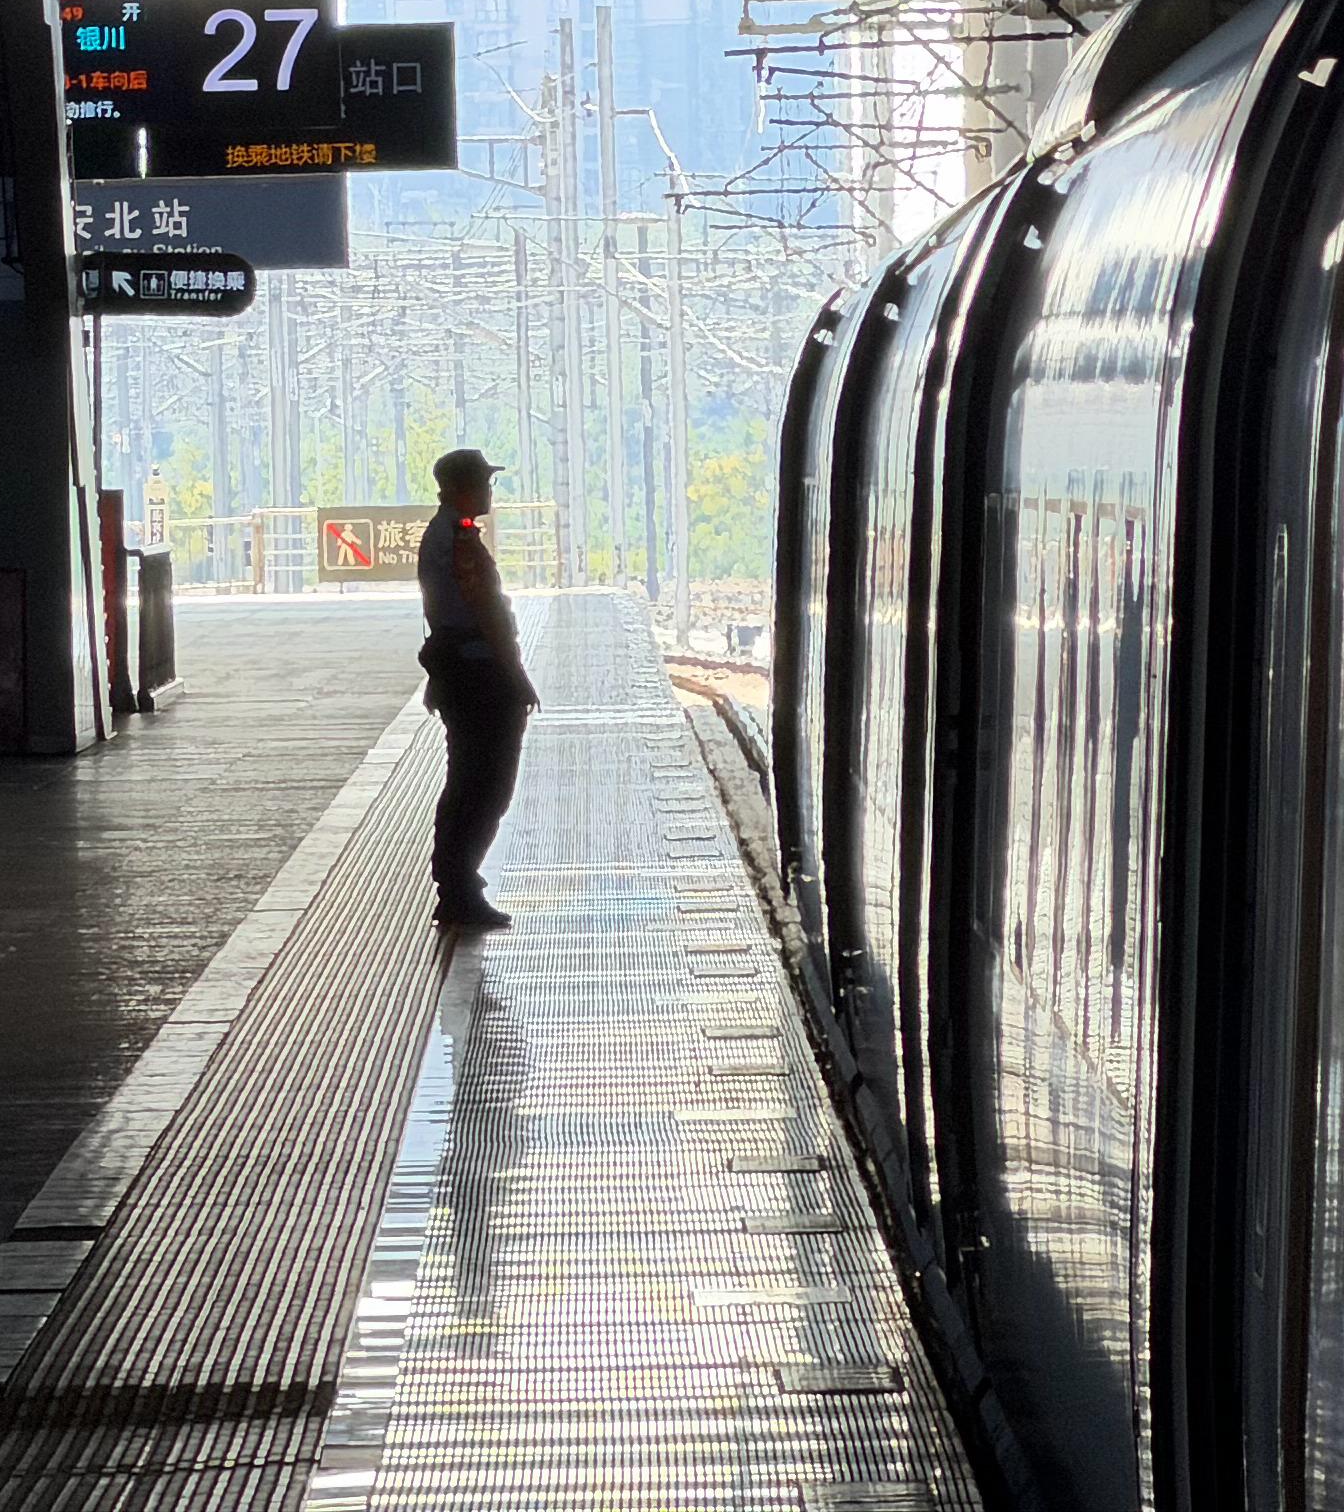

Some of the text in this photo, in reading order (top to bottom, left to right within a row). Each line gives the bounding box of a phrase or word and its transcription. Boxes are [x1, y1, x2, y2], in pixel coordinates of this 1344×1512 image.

[121, 2, 142, 22] 开
[76, 26, 126, 51] 银川
[203, 8, 319, 92] 27
